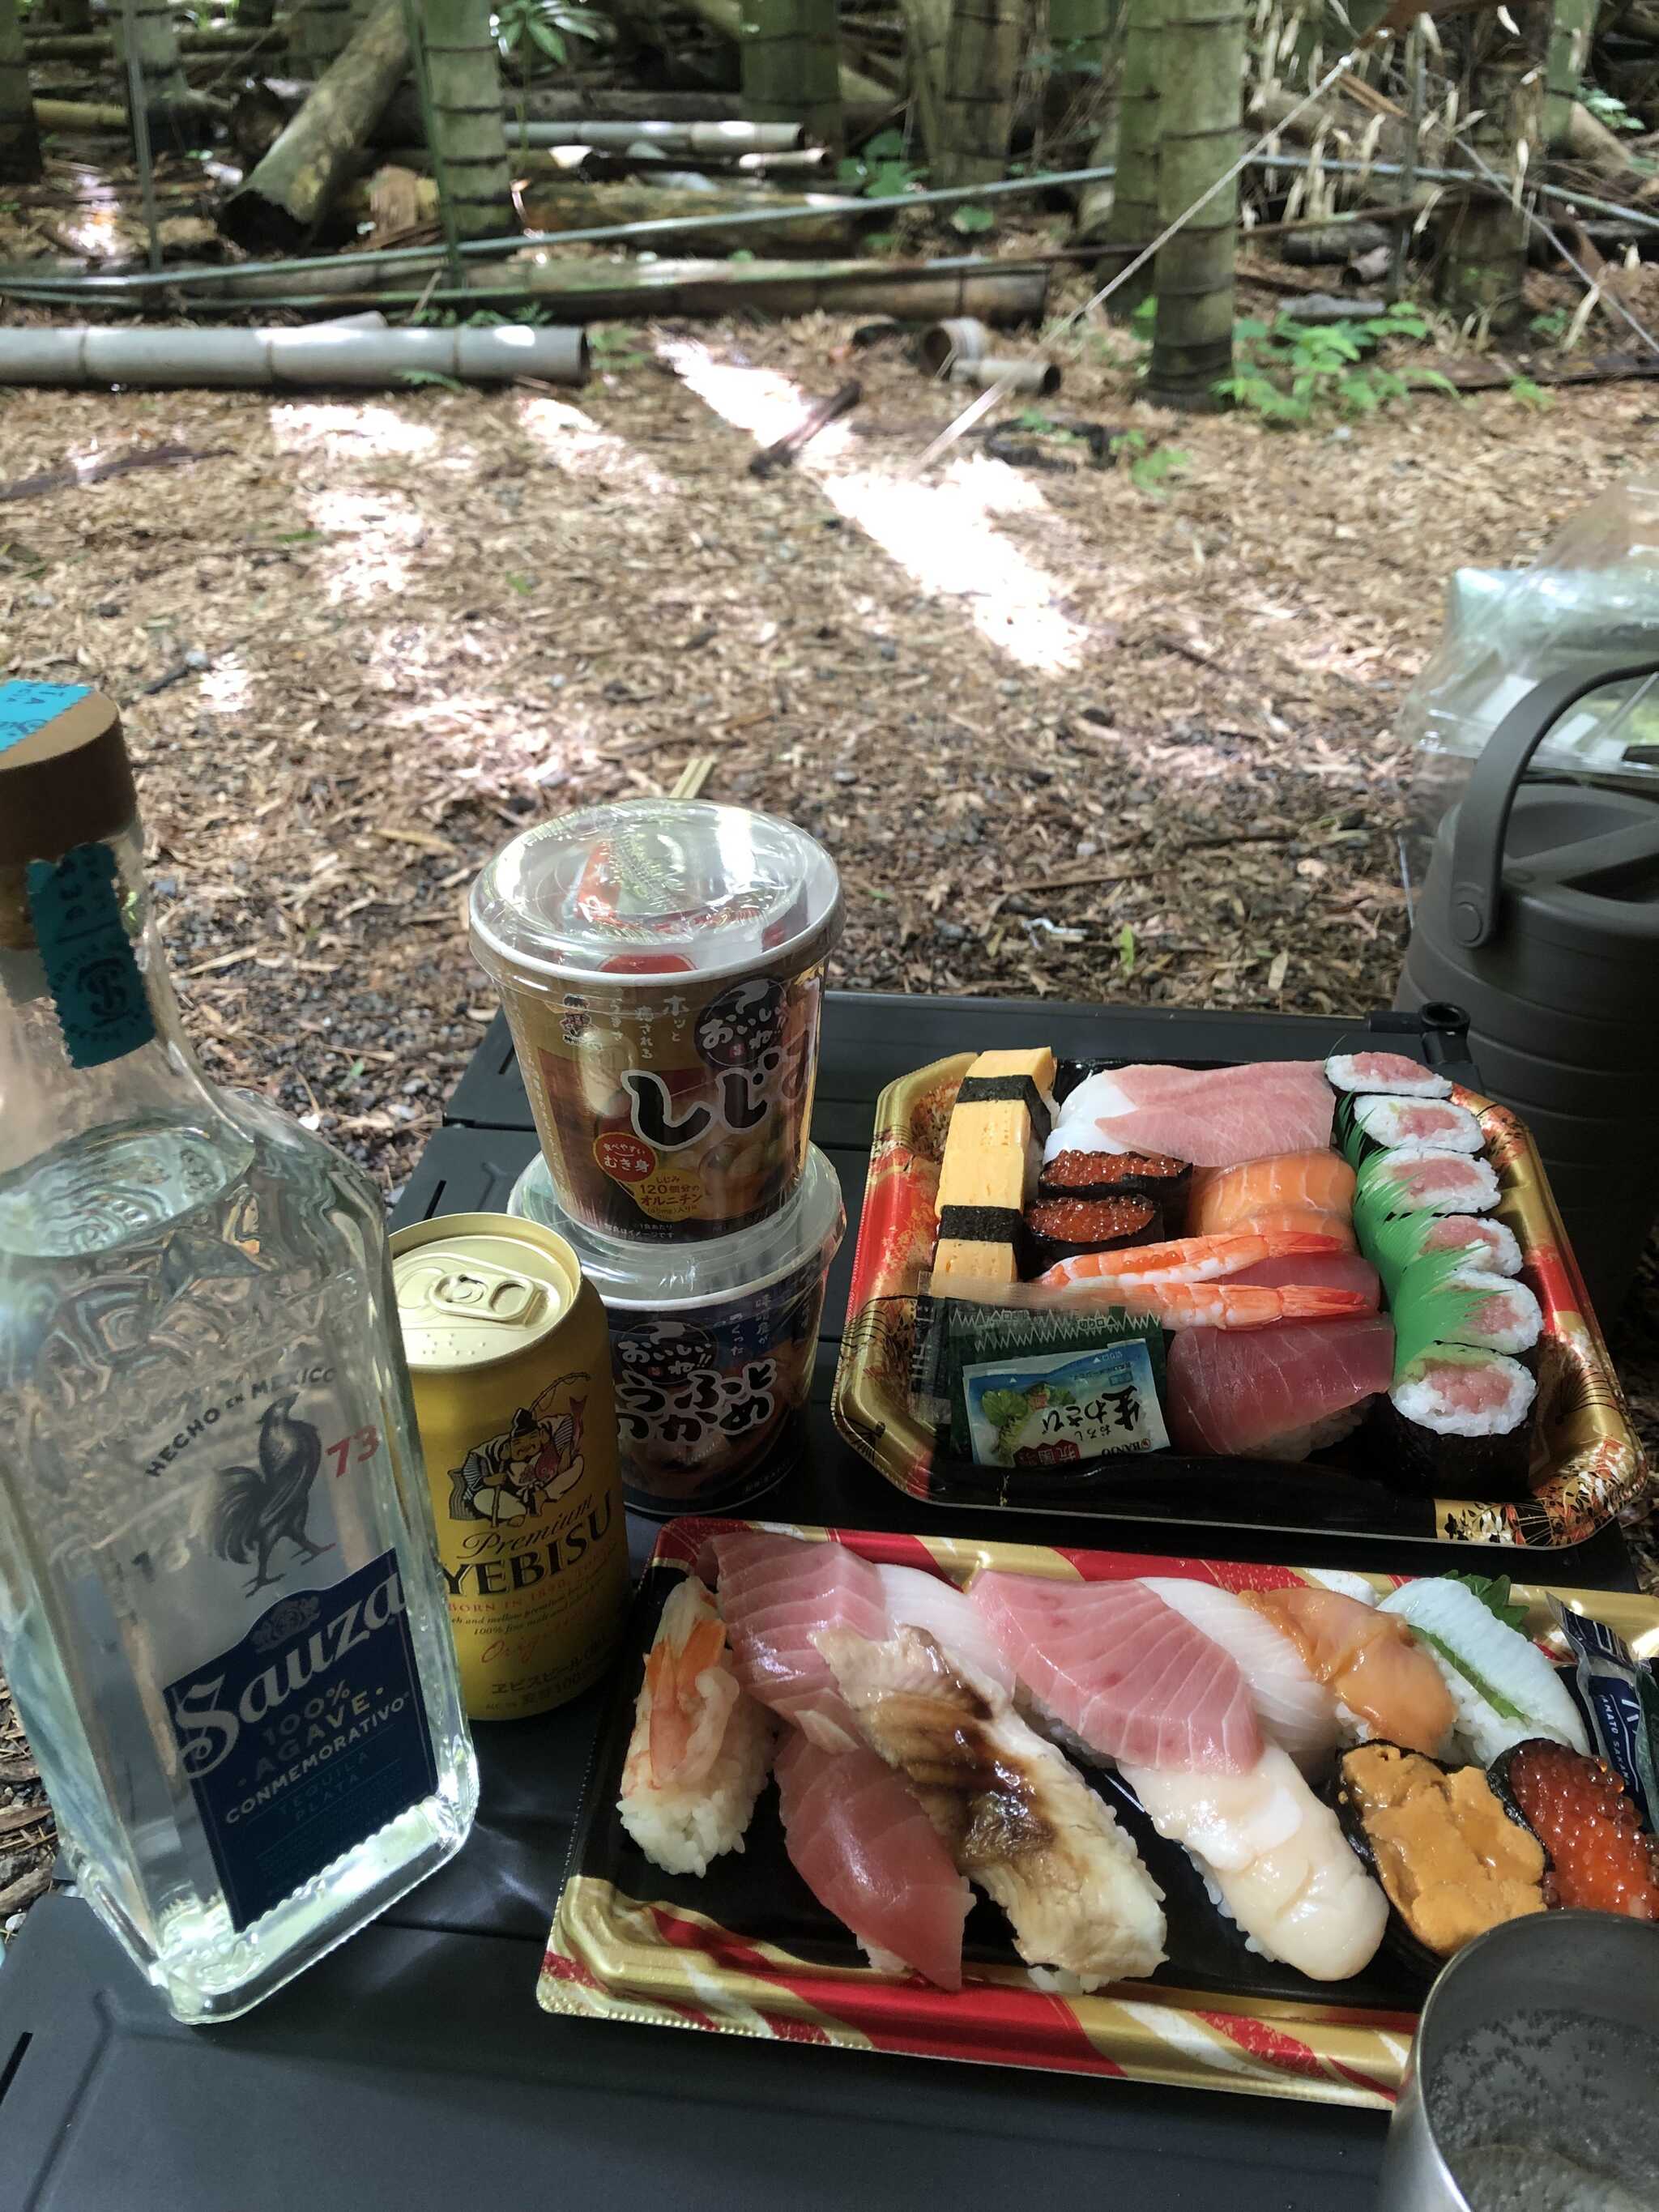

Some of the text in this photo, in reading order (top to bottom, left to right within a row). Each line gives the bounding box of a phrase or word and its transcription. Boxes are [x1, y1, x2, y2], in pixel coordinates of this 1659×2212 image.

[602, 1142, 646, 1156] 食べやすい
[603, 1155, 650, 1173] むき身
[639, 1183, 701, 1195] 120個分の
[640, 1193, 703, 1206] オルニチン
[655, 1174, 681, 1184] しじみ
[617, 1340, 711, 1364] おいしい
[1042, 1385, 1140, 1433] 生わさび
[1073, 1423, 1111, 1441] おろし
[144, 1405, 222, 1478] HECHO
[324, 1425, 380, 1478] 73
[441, 1489, 612, 1596] YEBISU
[456, 1494, 594, 1560] Premium
[173, 1570, 406, 1781] Sauza
[262, 1678, 351, 1745] 100%
[225, 1697, 407, 1826] CONMEMORATIVO
